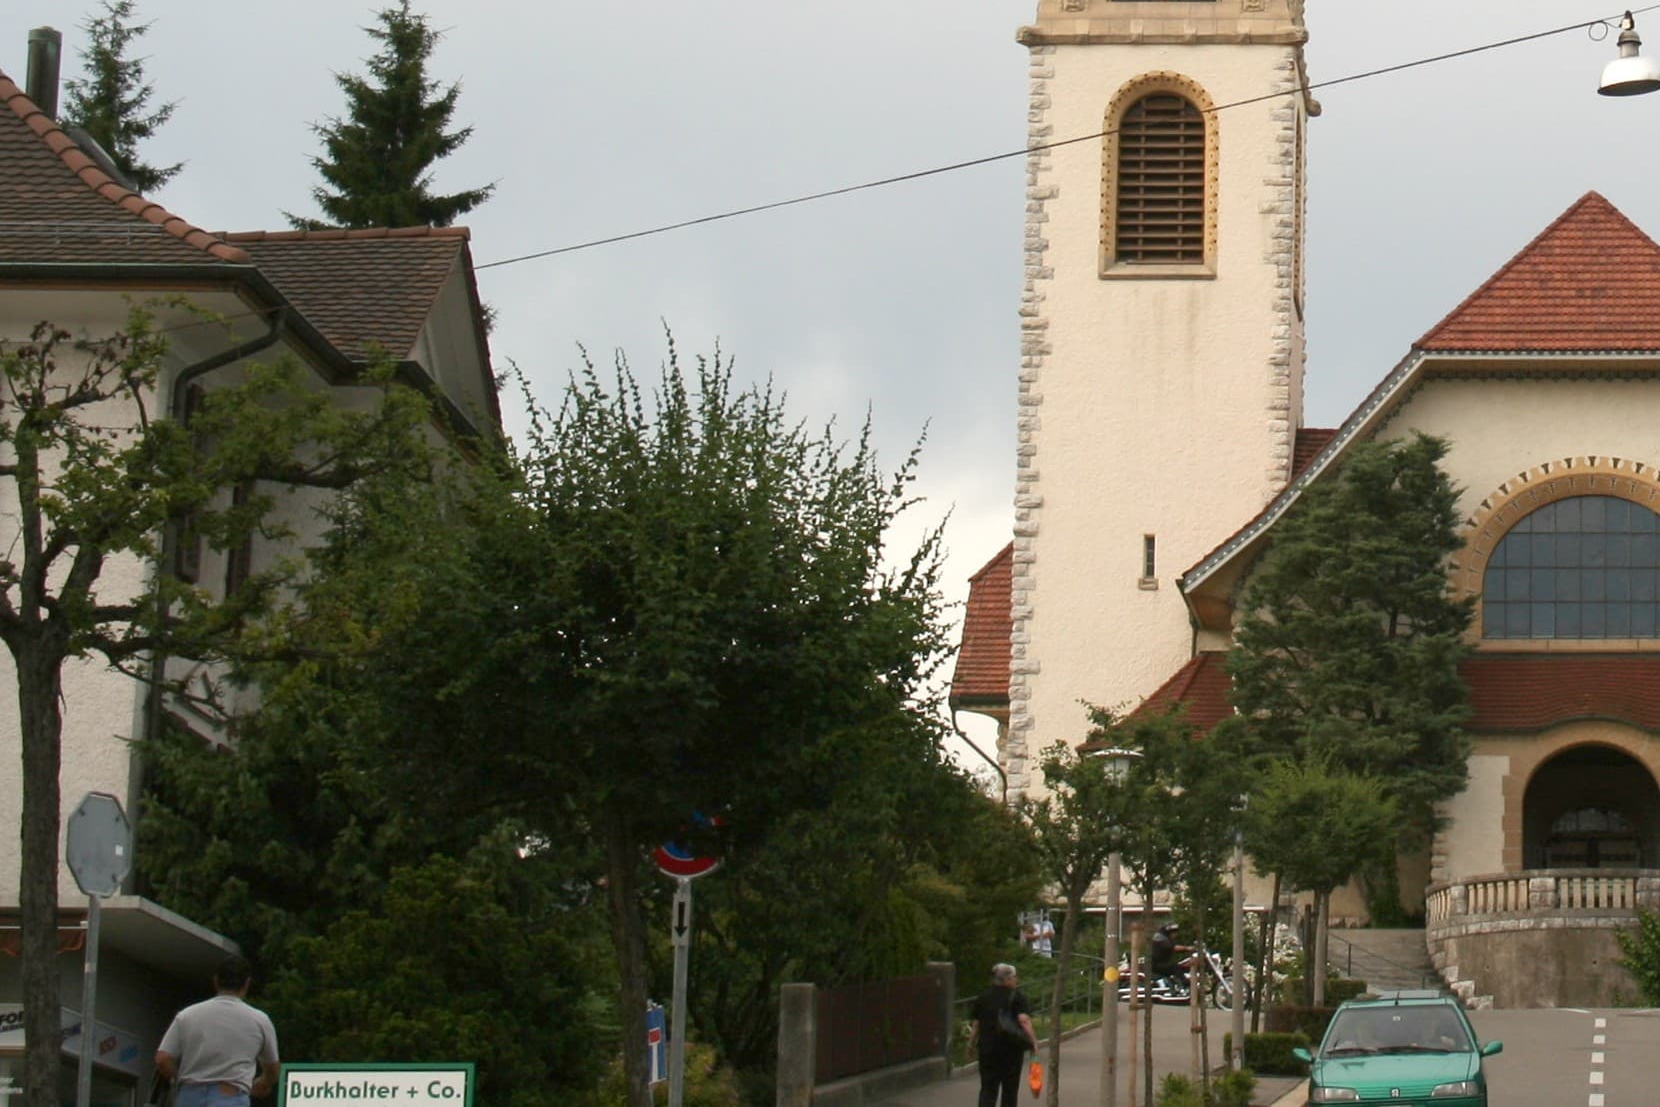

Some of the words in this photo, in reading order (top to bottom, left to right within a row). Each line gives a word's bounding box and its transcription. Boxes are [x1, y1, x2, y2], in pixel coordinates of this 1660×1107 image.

[290, 1080, 399, 1099] Burkhalter
[406, 1086, 419, 1099] +
[427, 1080, 461, 1099] Co.
